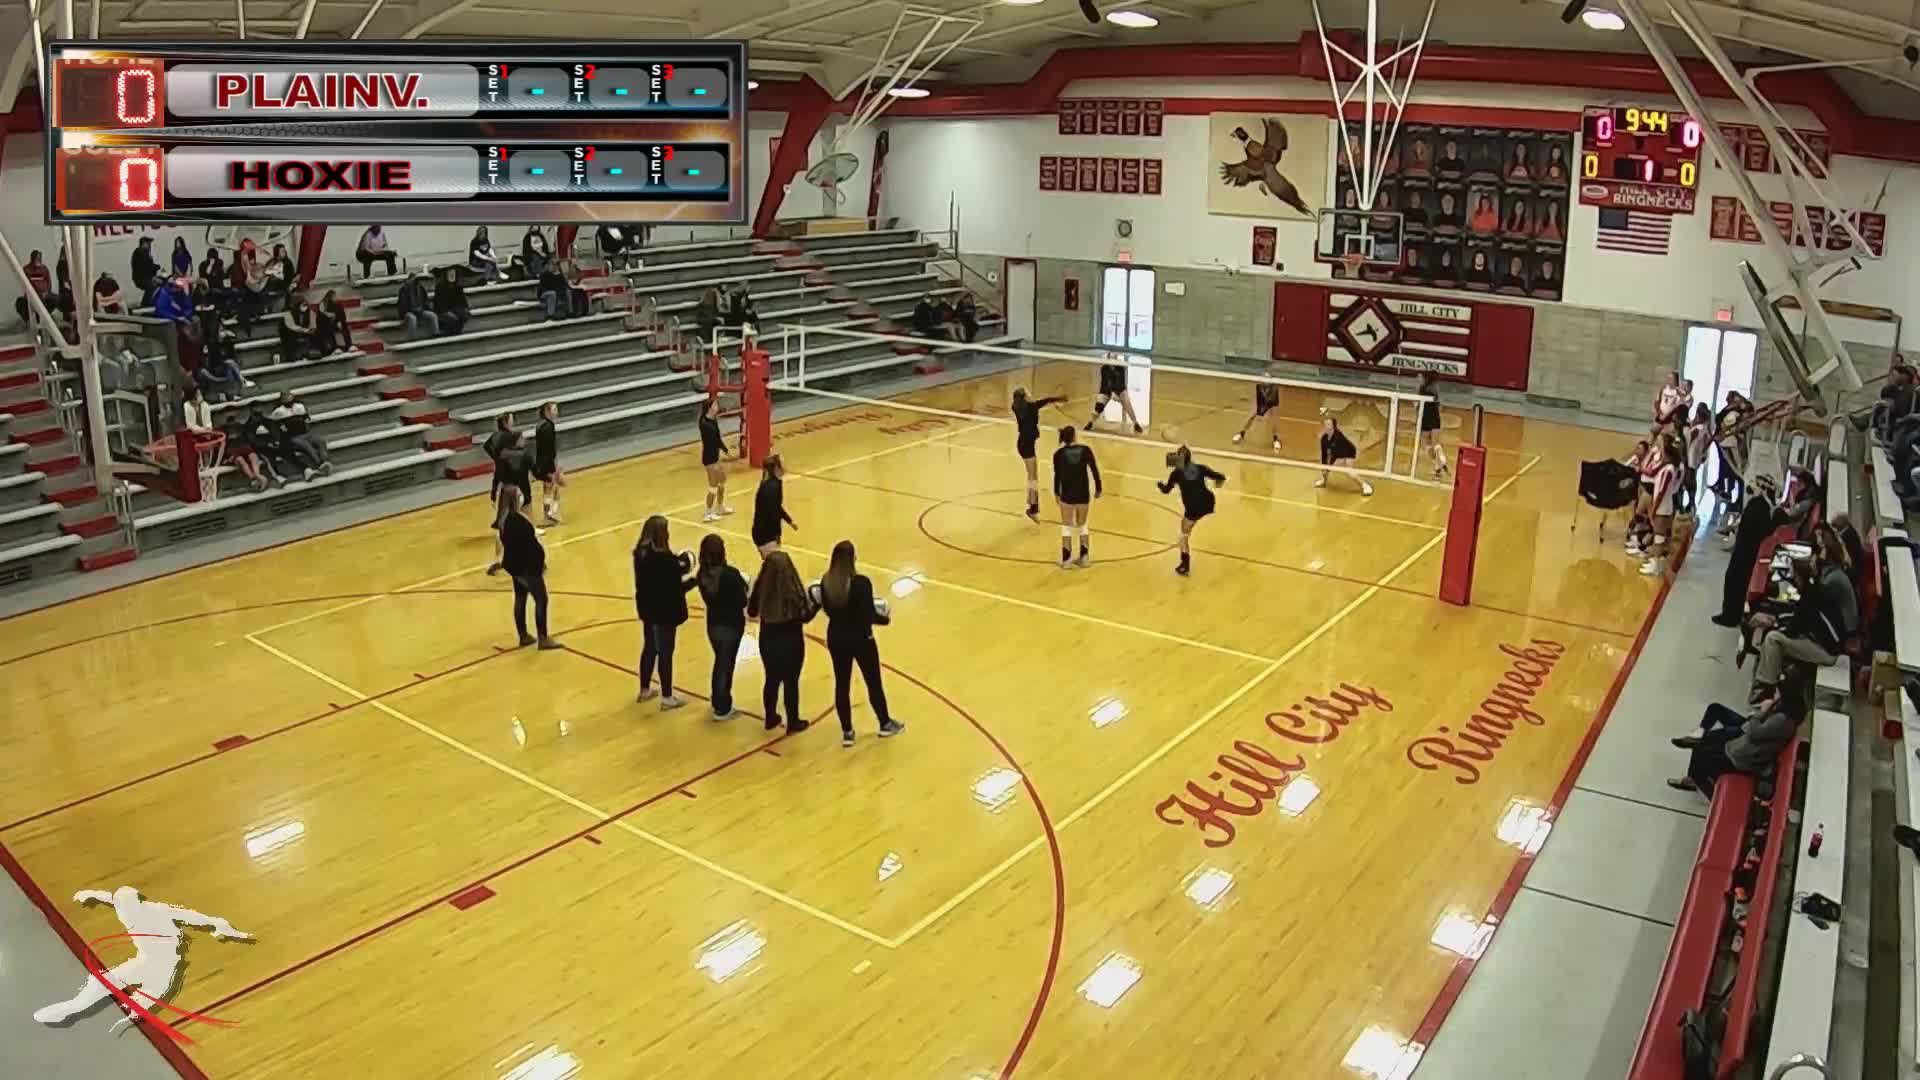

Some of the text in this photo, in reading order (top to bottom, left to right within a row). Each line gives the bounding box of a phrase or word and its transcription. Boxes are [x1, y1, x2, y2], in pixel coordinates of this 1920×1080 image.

[1682, 121, 1700, 148] 0
[1585, 155, 1598, 178] 0
[1680, 162, 1696, 186] 0
[1613, 193, 1693, 210] RINGNECKS
[1400, 303, 1460, 318] HILL CITY
[1407, 639, 1565, 785] Ringnecks
[1155, 682, 1394, 848] Hill City
